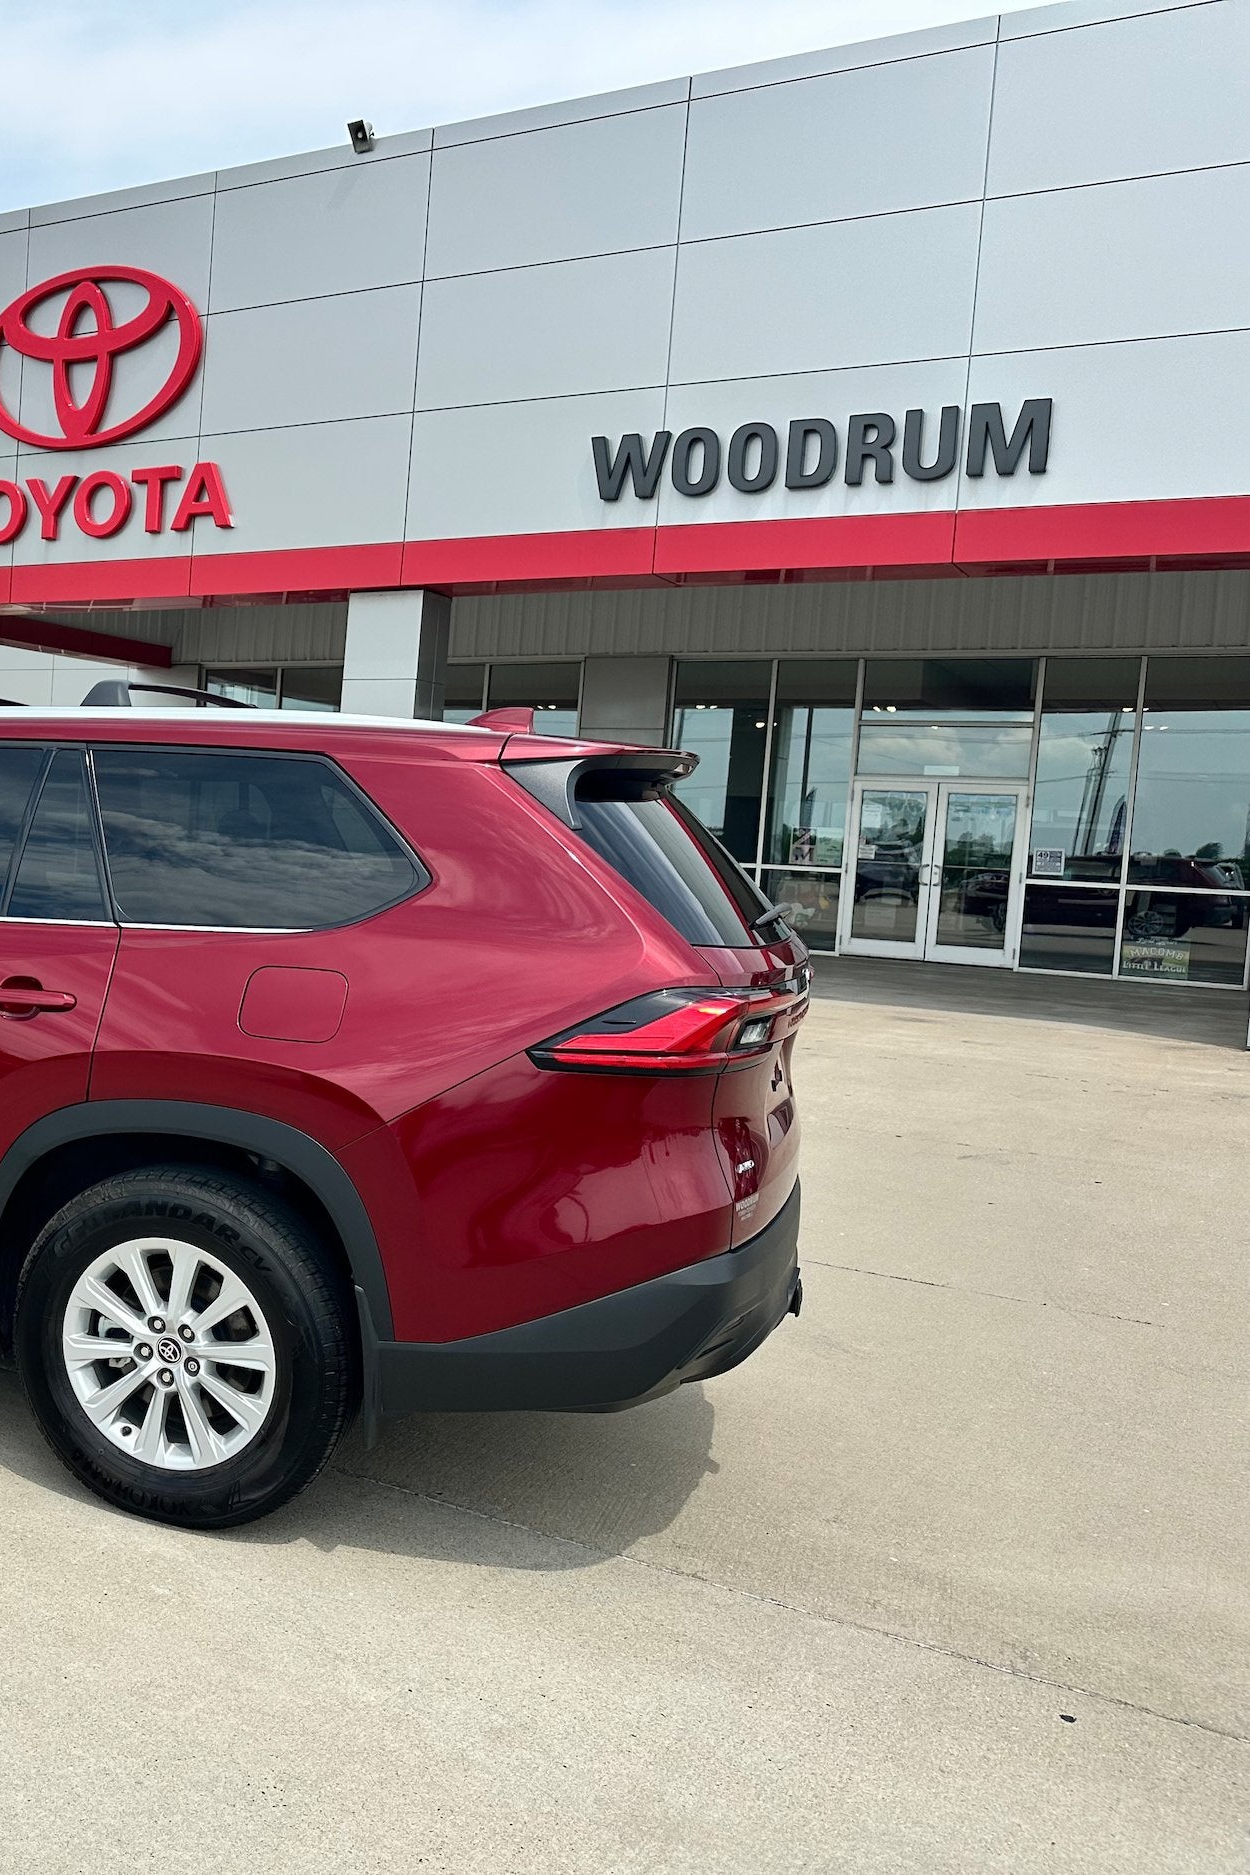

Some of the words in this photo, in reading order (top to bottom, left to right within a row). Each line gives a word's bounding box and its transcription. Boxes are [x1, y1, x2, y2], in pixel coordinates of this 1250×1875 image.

[591, 397, 1053, 501] WOODRUM
[1129, 946, 1184, 961] MACOMB
[53, 1199, 242, 1258] GEANDAR
